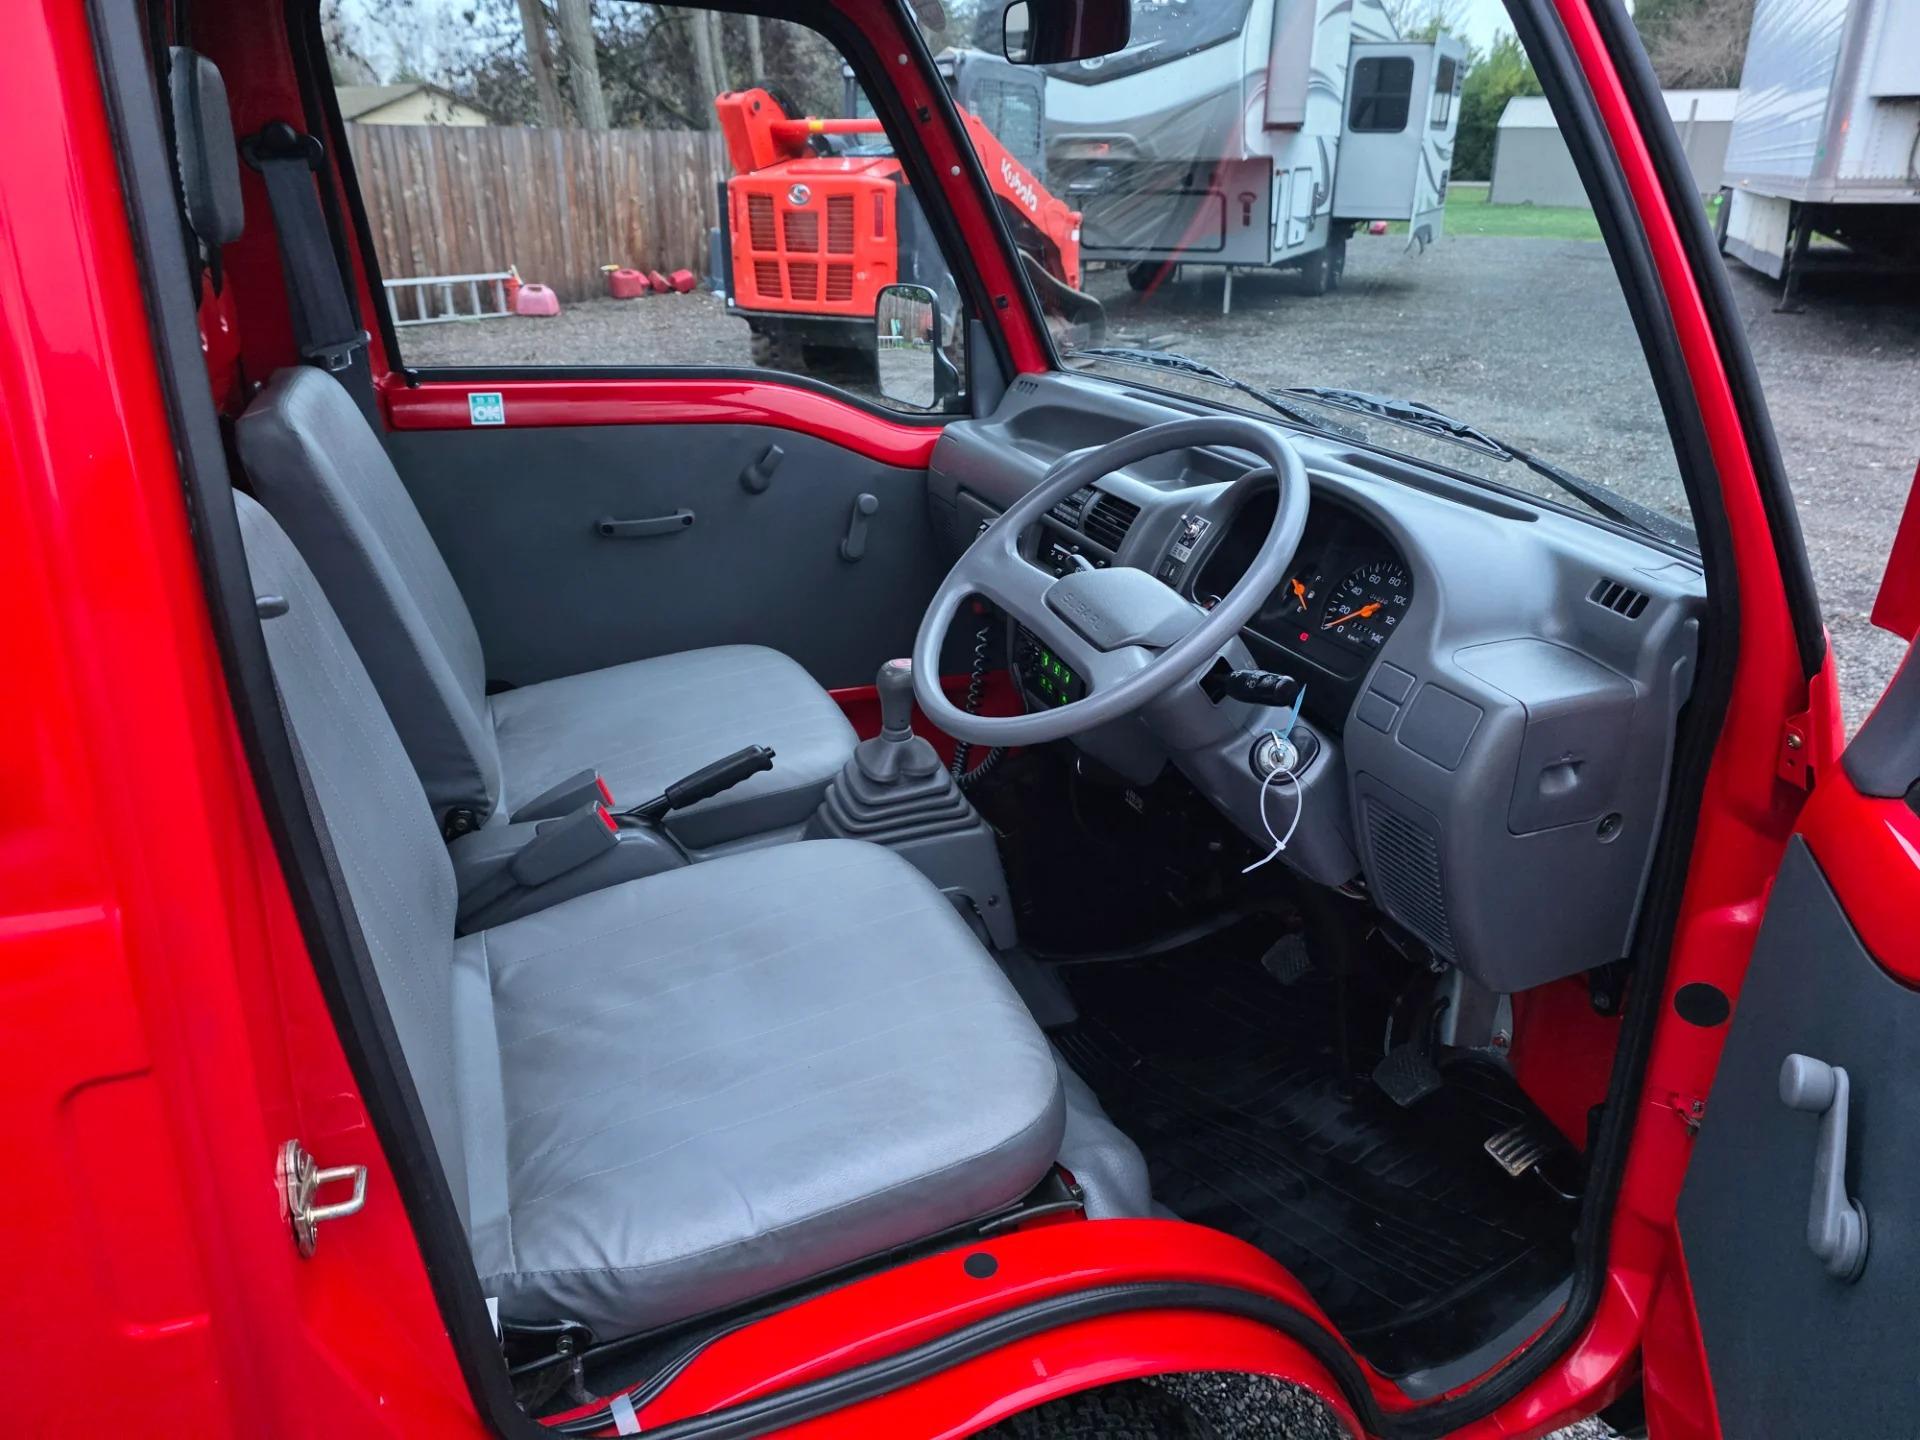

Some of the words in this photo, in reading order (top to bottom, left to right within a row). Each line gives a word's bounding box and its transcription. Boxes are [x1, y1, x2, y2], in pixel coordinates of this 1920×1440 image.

[1001, 158, 1037, 212] Kubota
[1369, 575, 1381, 585] 60
[1389, 577, 1401, 587] 80
[1351, 586, 1363, 596] 40
[1339, 604, 1351, 614] 20
[1385, 616, 1396, 625] 12
[1336, 625, 1344, 633] 0
